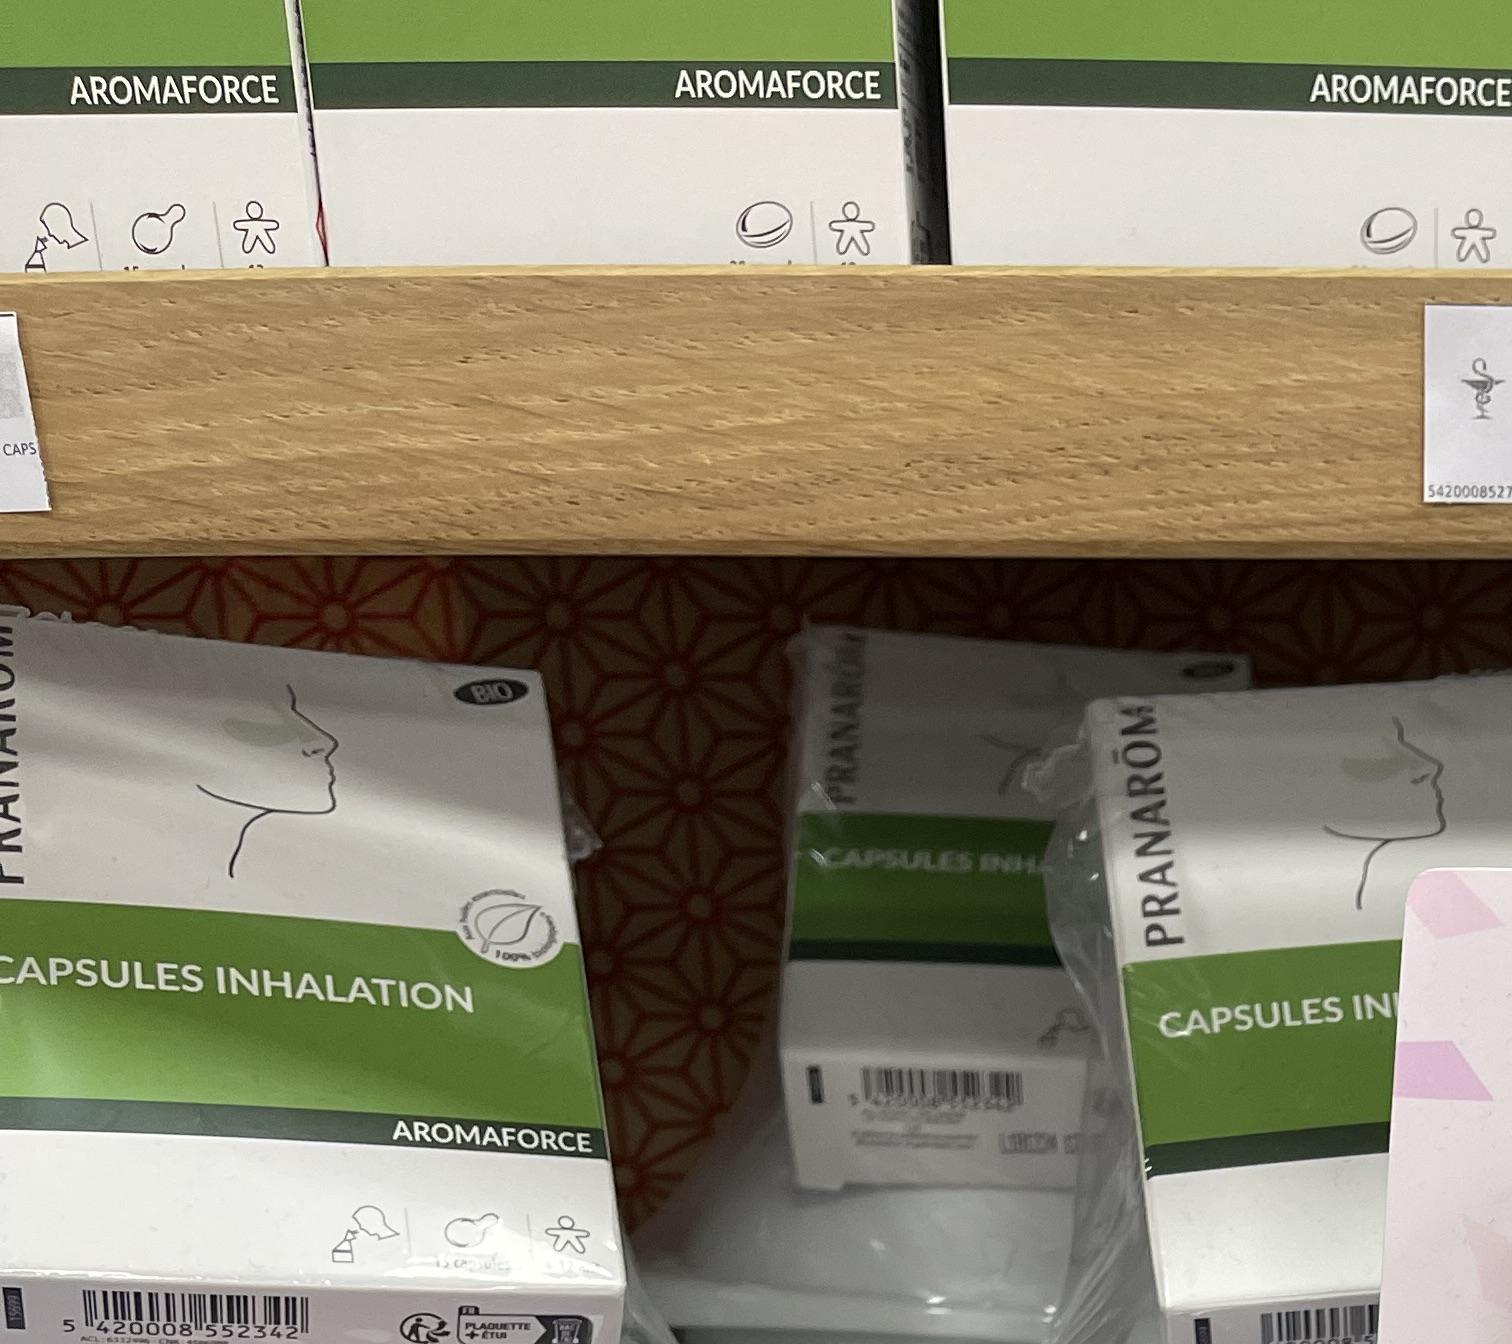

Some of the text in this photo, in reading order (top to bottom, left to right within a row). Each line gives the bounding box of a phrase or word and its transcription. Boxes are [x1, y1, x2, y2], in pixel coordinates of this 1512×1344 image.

[70, 74, 280, 107] AROMAFORCE
[674, 68, 882, 101] AROMAFORCE
[1309, 73, 1512, 109] AROMAFORCE
[215, 965, 475, 1015] INHALATION
[1158, 997, 1344, 1039] CAPSULES
[392, 1119, 593, 1153] AROMAFORCE
[62, 1319, 299, 1340] 5 420008 552342
[464, 1322, 531, 1331] PLAQUETTE
